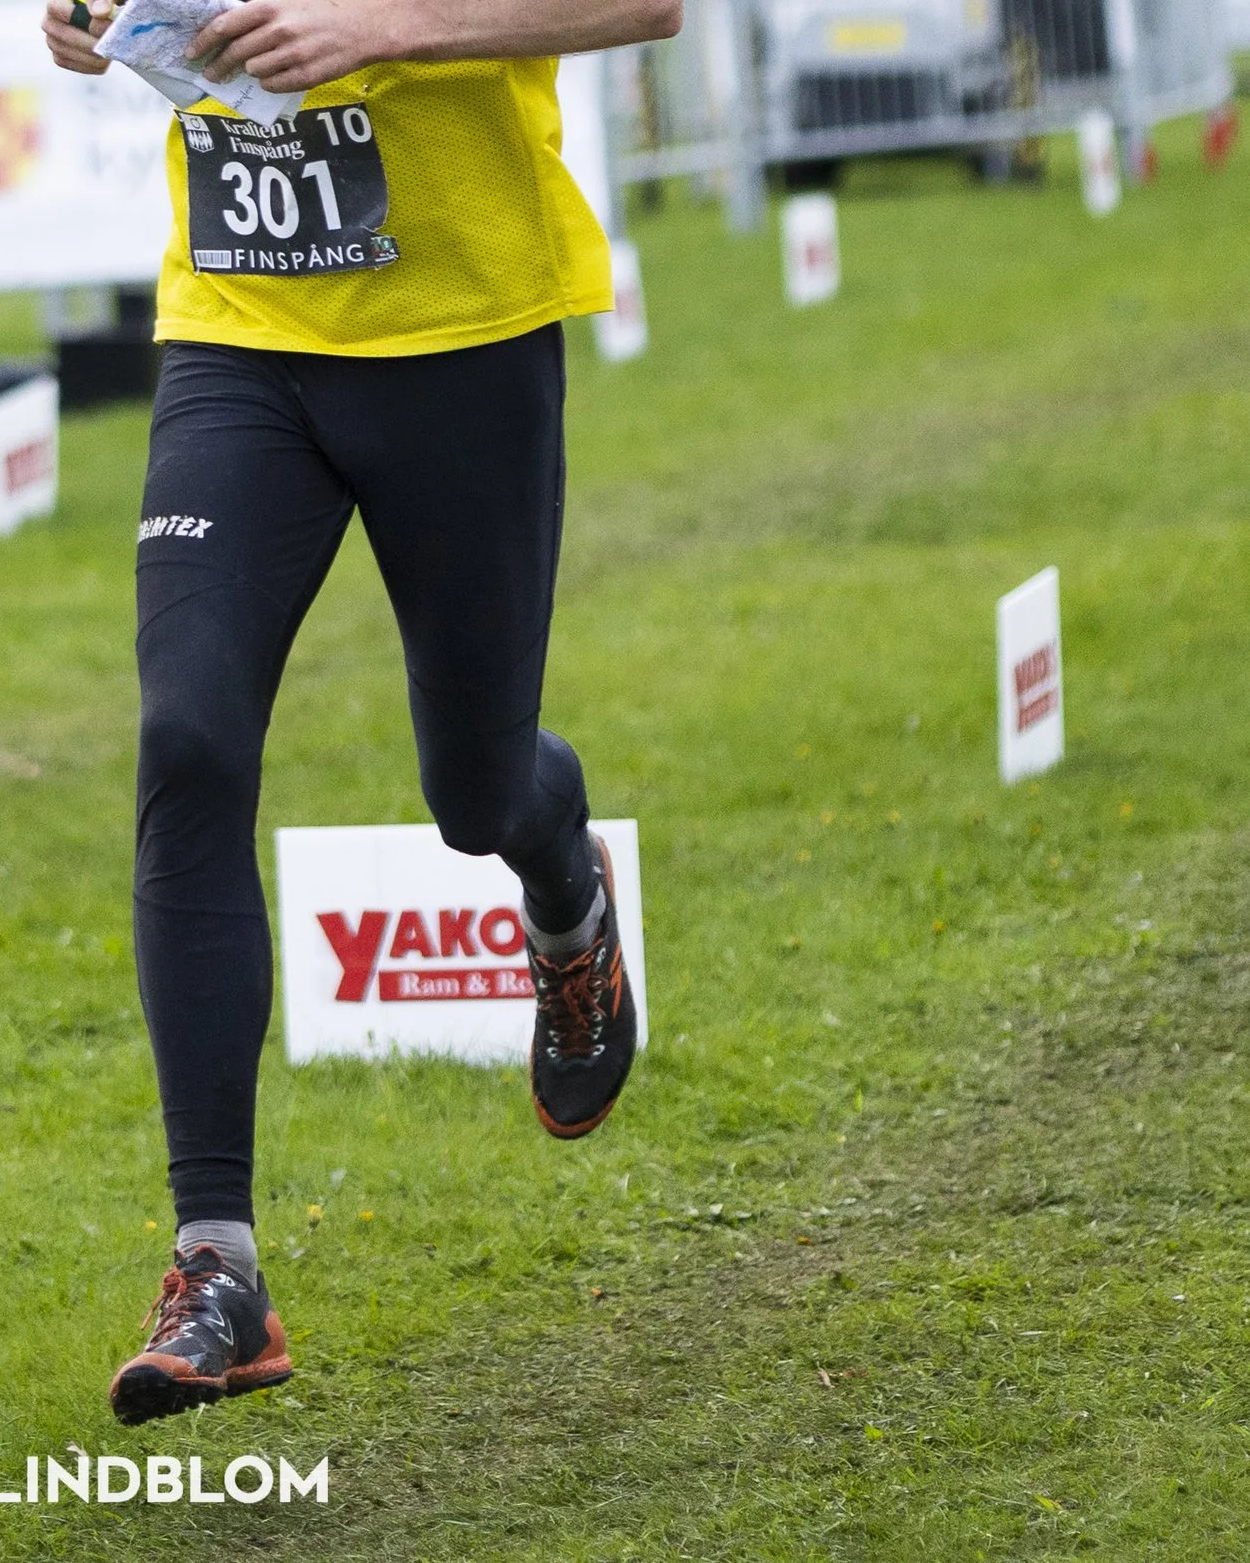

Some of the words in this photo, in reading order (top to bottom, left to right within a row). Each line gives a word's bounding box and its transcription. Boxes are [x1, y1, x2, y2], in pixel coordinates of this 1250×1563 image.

[220, 118, 285, 140] Kraften
[316, 107, 372, 147] 10
[229, 136, 306, 162] Finspång
[221, 160, 342, 239] 301
[235, 243, 365, 270] FINSPÅNG
[317, 908, 527, 1002] YAKO
[400, 972, 460, 997] Ram
[464, 972, 491, 996] &
[499, 972, 536, 995] Re
